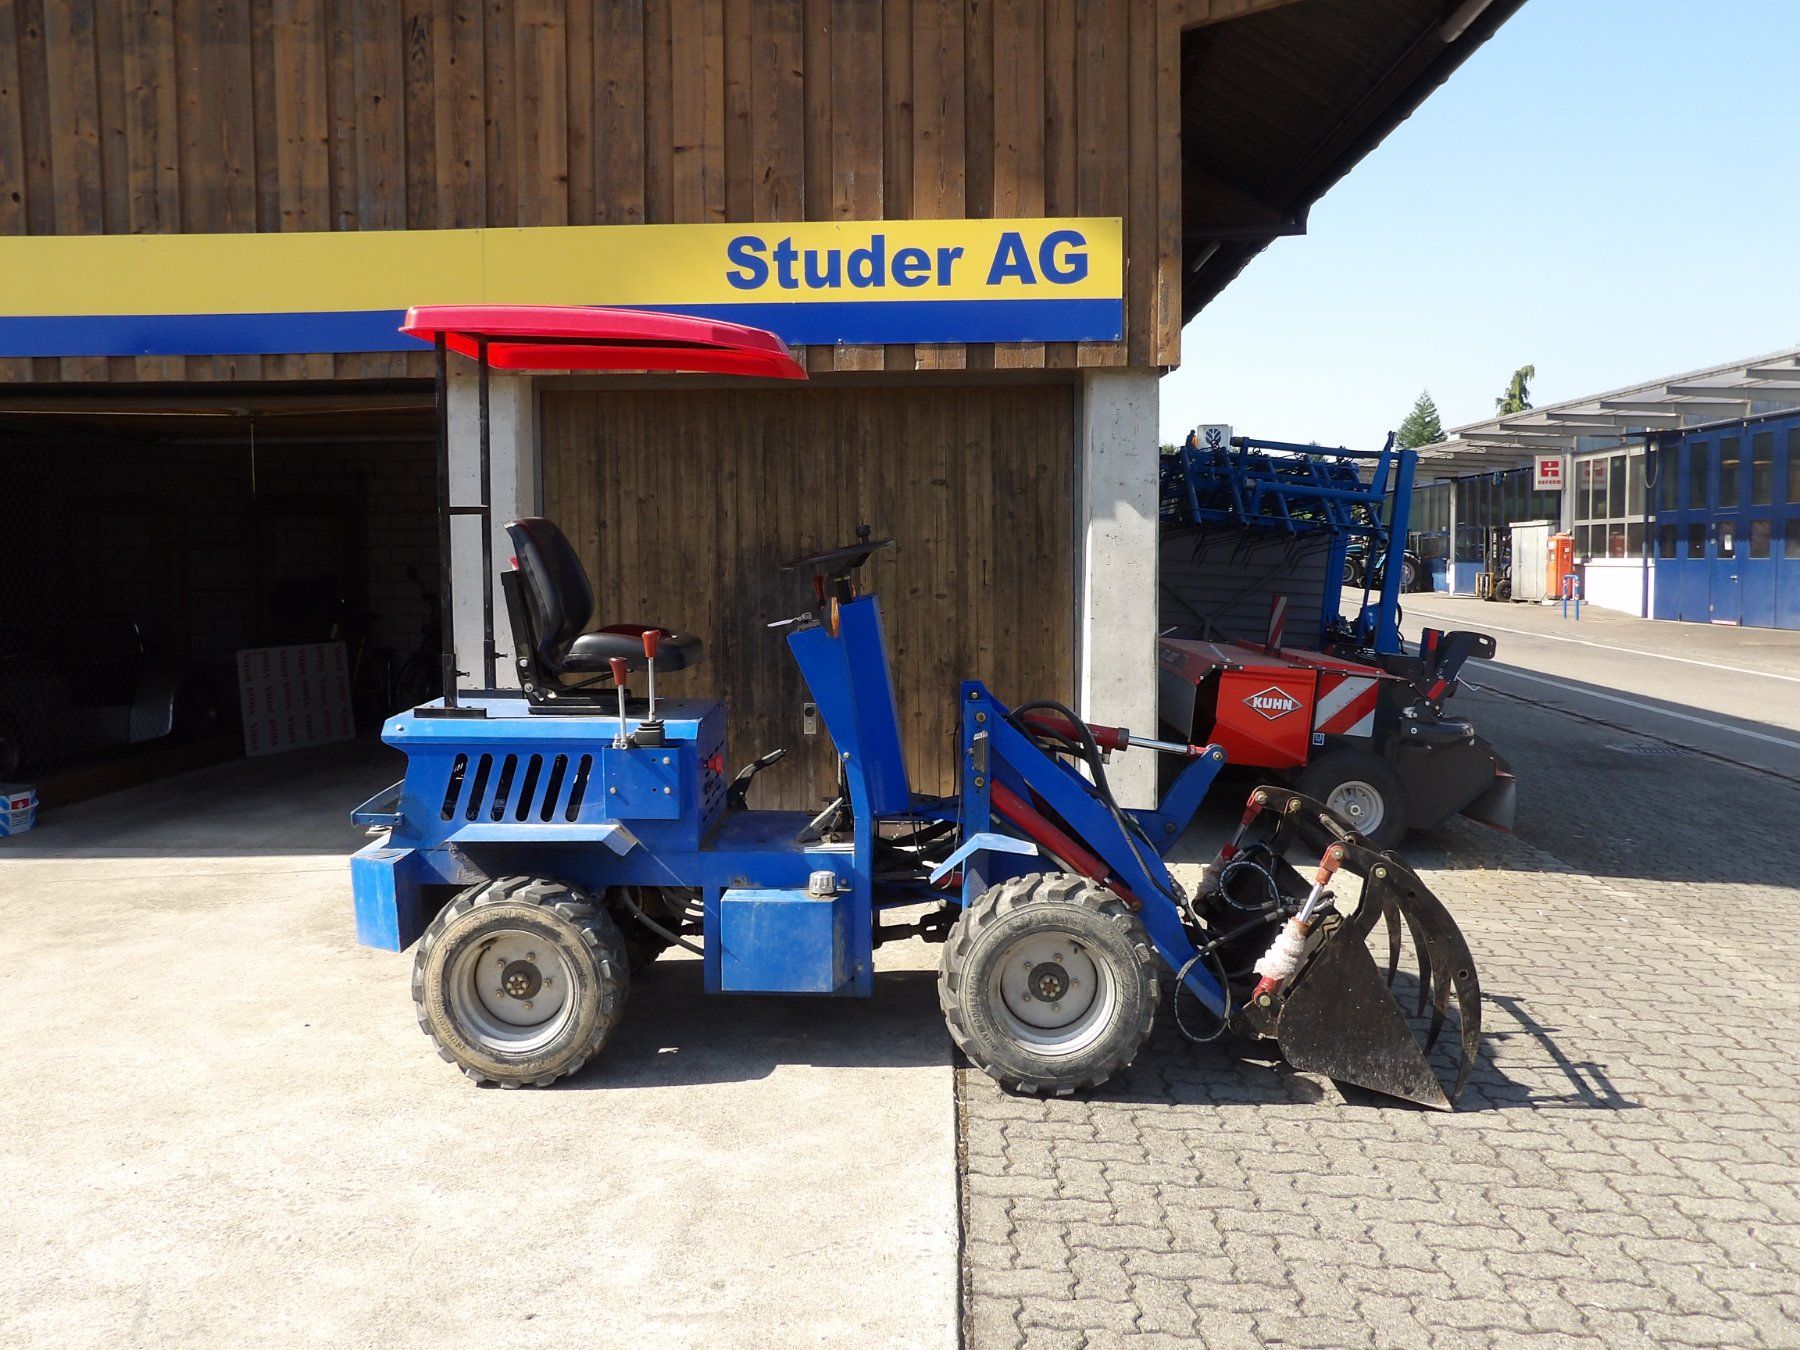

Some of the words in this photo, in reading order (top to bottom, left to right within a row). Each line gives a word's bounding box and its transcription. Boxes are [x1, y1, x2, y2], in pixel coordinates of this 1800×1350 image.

[725, 233, 964, 290] Studer
[986, 230, 1089, 285] AG
[1252, 697, 1293, 711] KUHN
